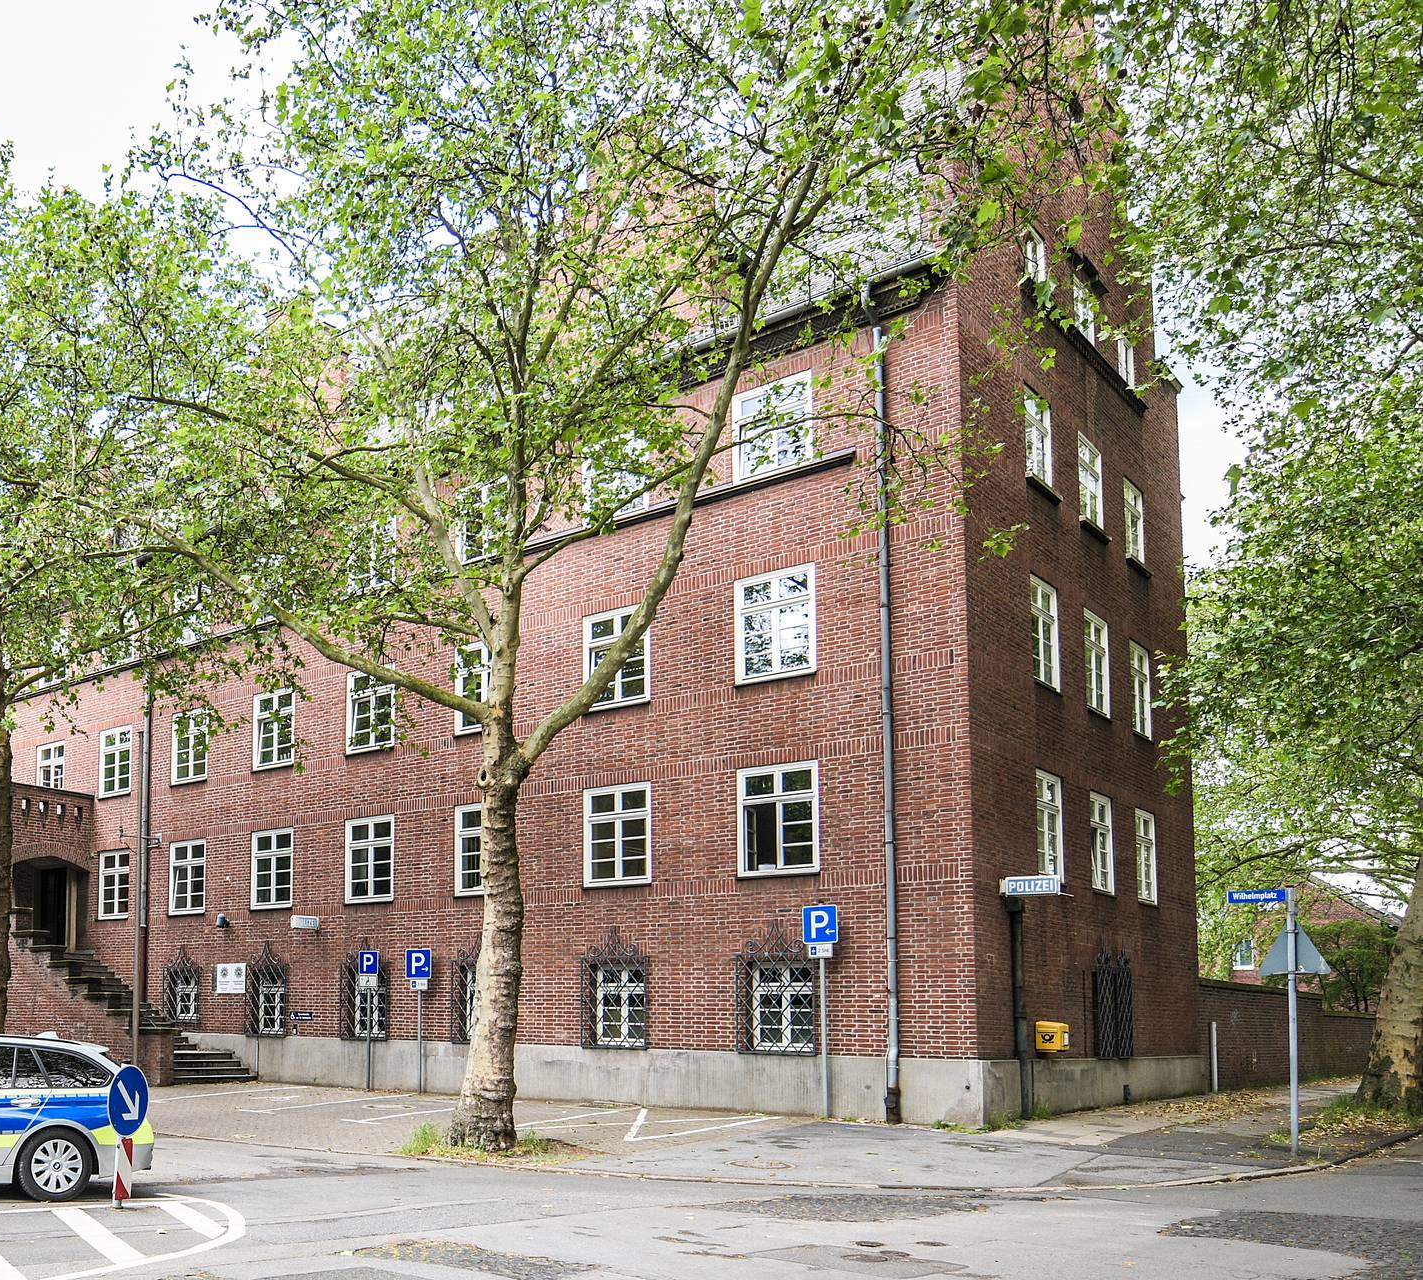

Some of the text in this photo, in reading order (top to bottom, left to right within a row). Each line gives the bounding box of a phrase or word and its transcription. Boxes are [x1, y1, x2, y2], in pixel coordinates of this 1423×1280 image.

[1009, 880, 1054, 892] POLIZEI
[1232, 892, 1278, 900] Wilhelmplatz
[810, 910, 829, 939] P
[363, 953, 374, 972] P
[411, 952, 425, 975] P
